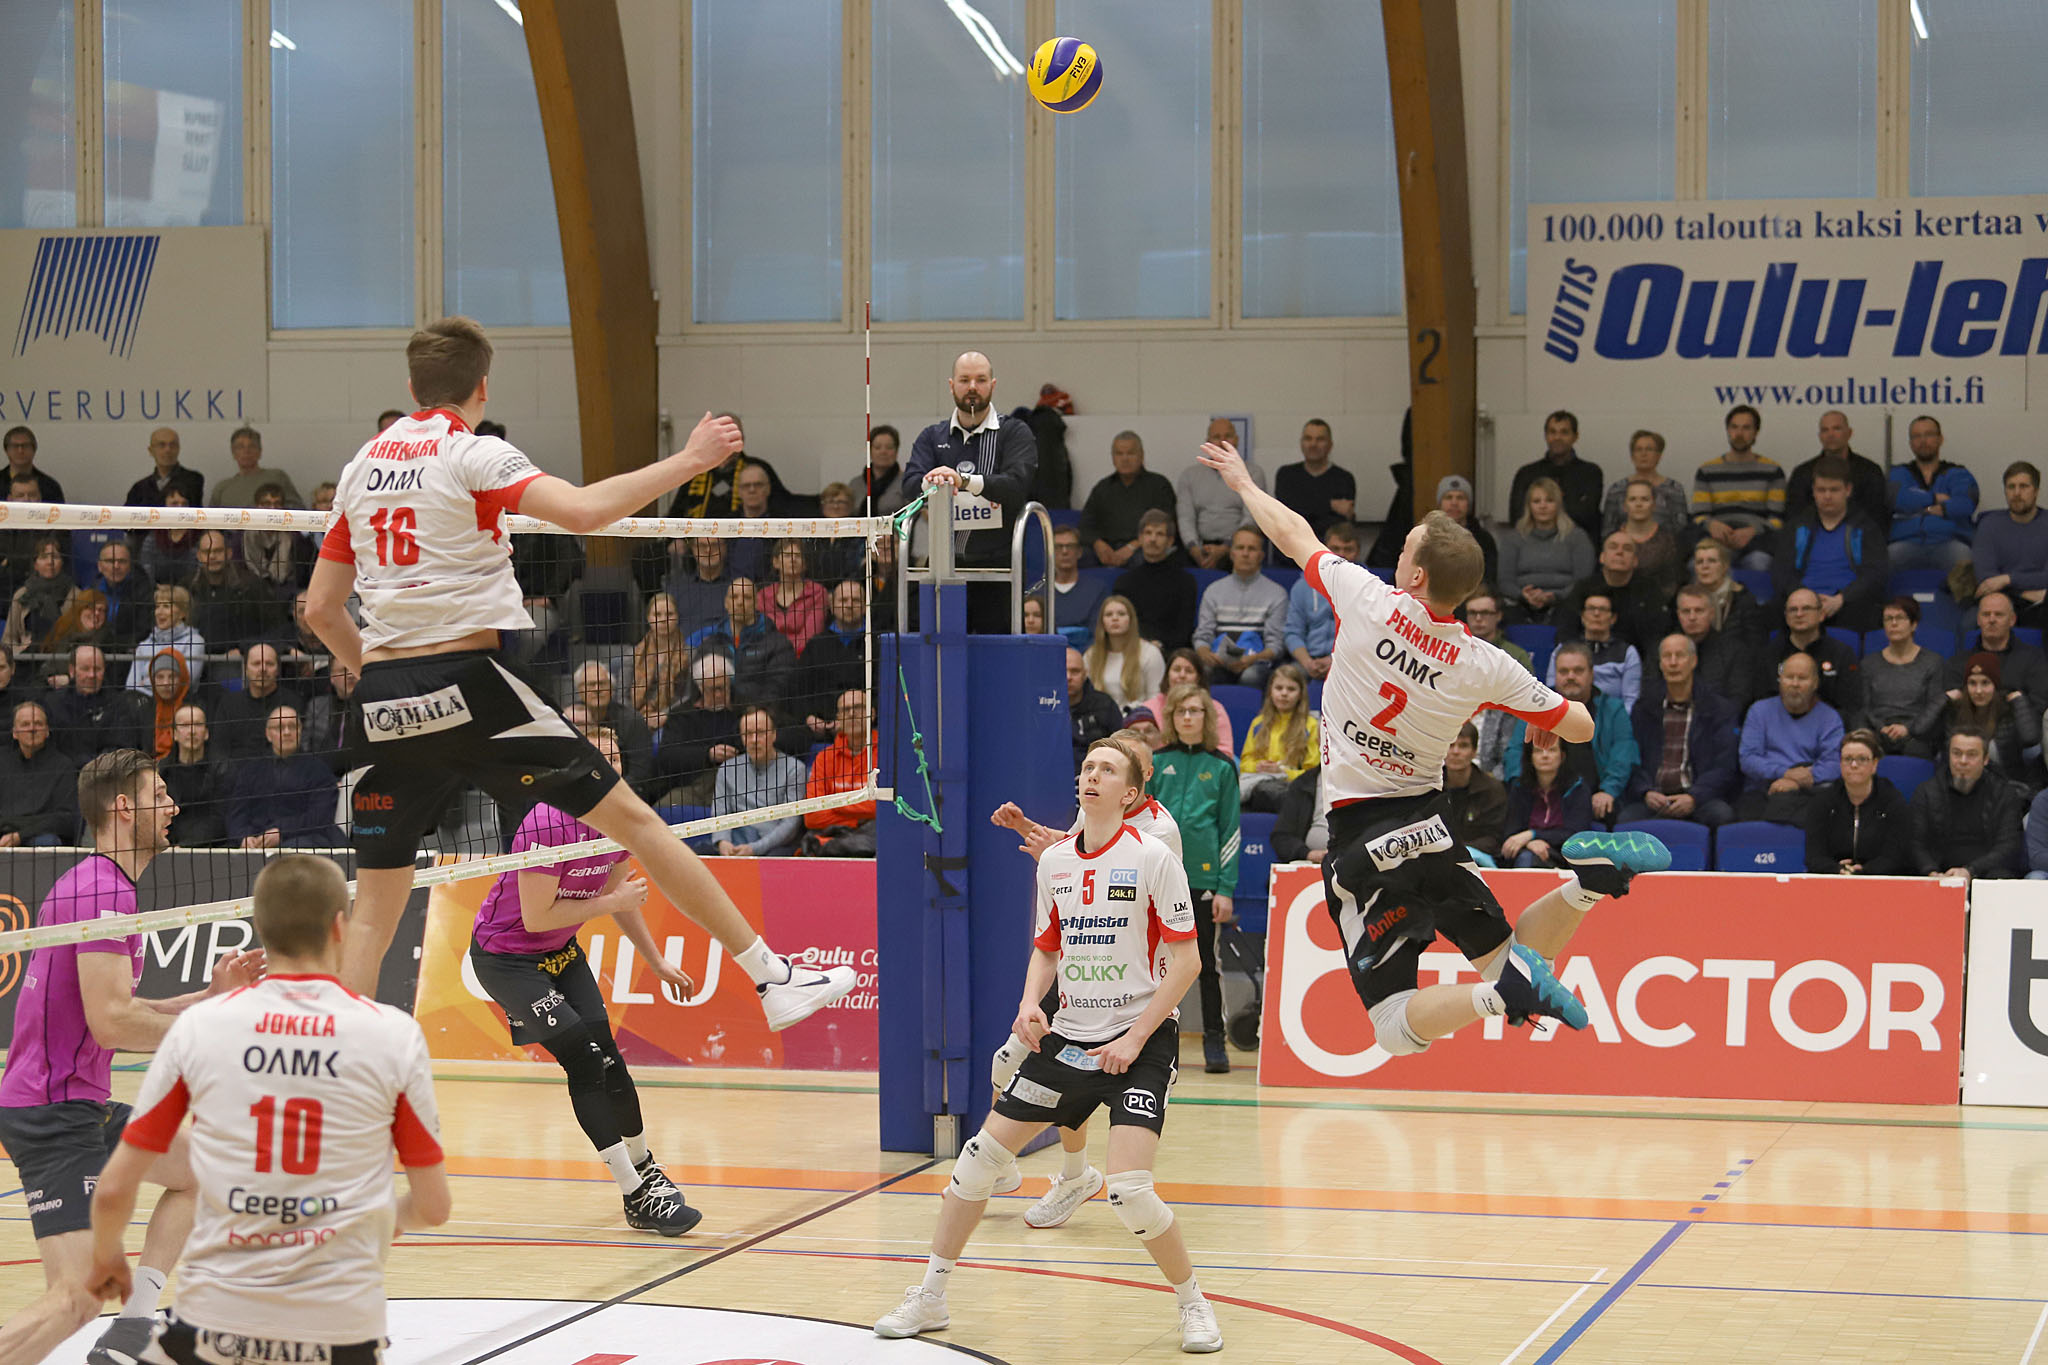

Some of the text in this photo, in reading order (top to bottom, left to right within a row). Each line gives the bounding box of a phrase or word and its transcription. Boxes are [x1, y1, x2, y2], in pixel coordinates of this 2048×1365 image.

[1543, 213, 1664, 242] 100.000
[1675, 213, 1803, 241] taloutta
[1814, 209, 1902, 239] kaksi
[1915, 208, 2024, 237] kertaa
[1543, 257, 1599, 364] UUTIS
[1416, 328, 1441, 385] 2
[1714, 375, 1985, 405] www.oululehti.fi
[369, 506, 421, 567] 16
[1385, 607, 1461, 666] PENNANEN
[1369, 681, 1408, 737] 2
[1082, 869, 1096, 905] 5
[1109, 888, 1134, 899] 24k.fi
[1111, 871, 1135, 883] OTC
[802, 946, 855, 965] Oulu
[255, 1012, 335, 1037] JOKELA
[547, 1014, 557, 1027] 6
[1128, 1094, 1154, 1110] PLC
[249, 1094, 324, 1176] 10
[228, 1186, 338, 1224] Ceegon
